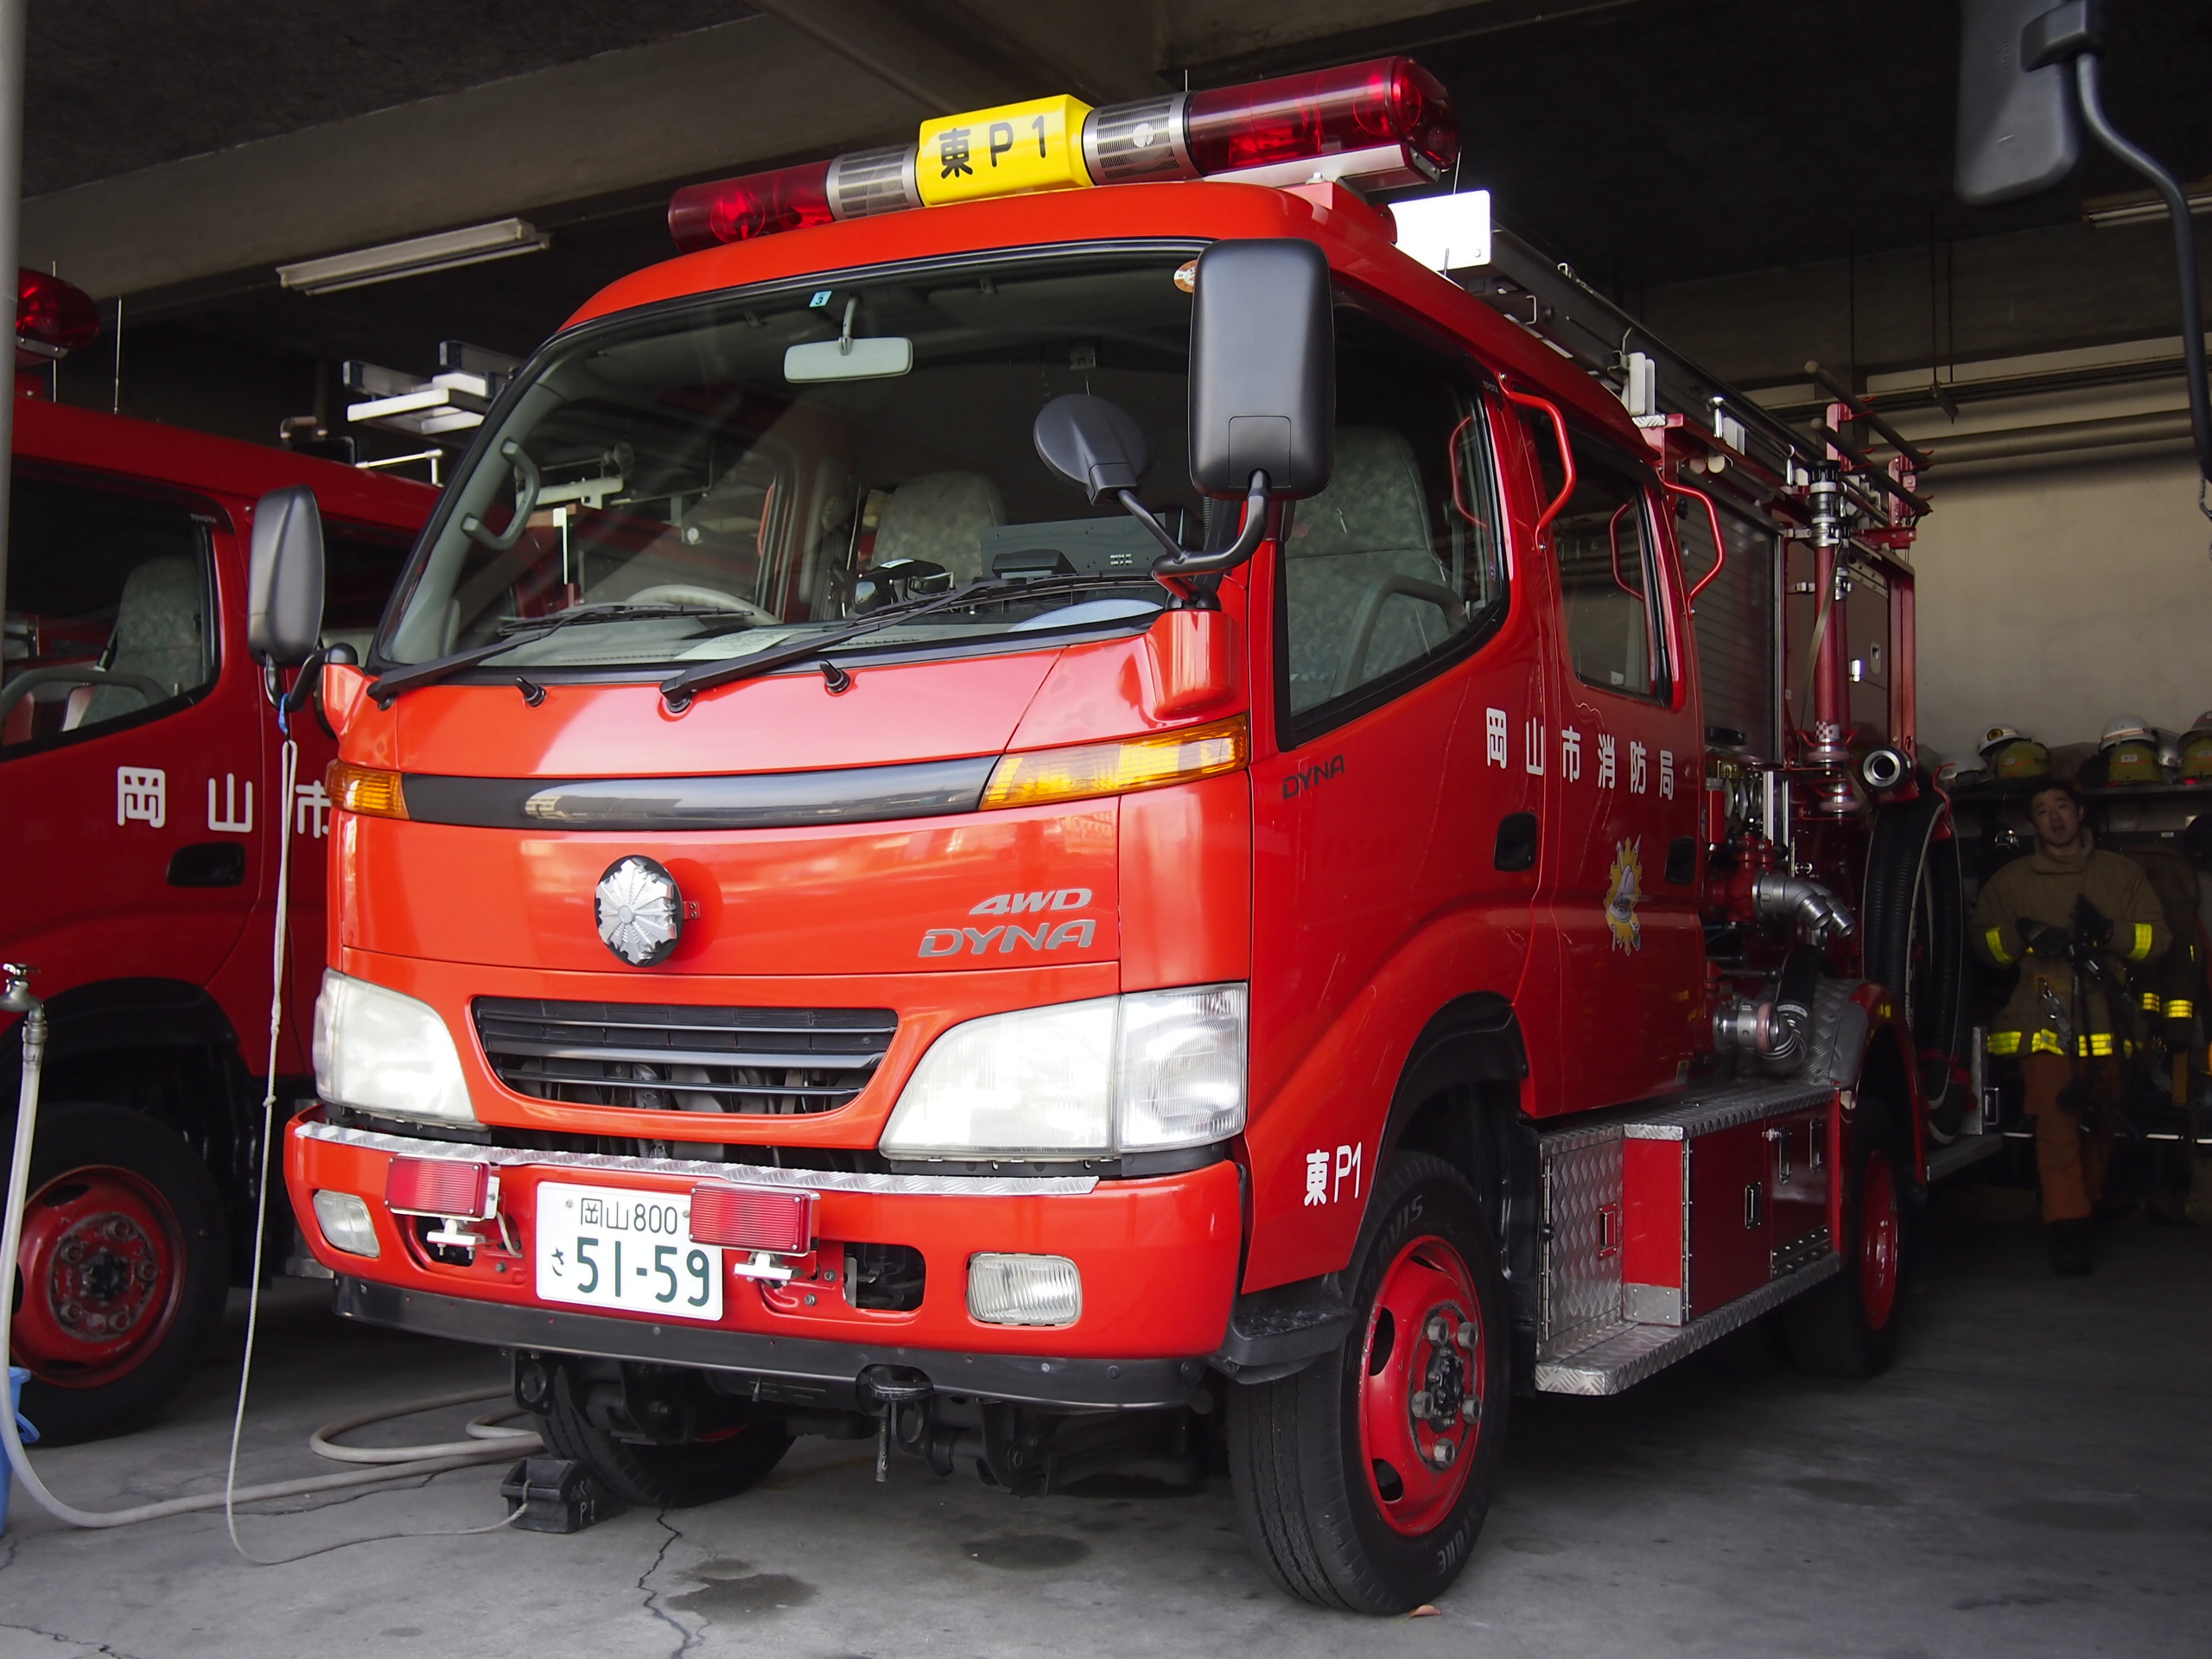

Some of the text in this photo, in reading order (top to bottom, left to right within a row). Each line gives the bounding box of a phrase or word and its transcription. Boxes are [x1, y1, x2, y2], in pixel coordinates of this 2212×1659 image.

[190, 513, 217, 524] TOYOTA
[1485, 707, 1675, 801] 岡山市消防局
[1282, 753, 1345, 799] DYNA
[969, 888, 1092, 915] 4WD
[918, 918, 1096, 957] DYNA
[576, 1236, 709, 1306] 51-59
